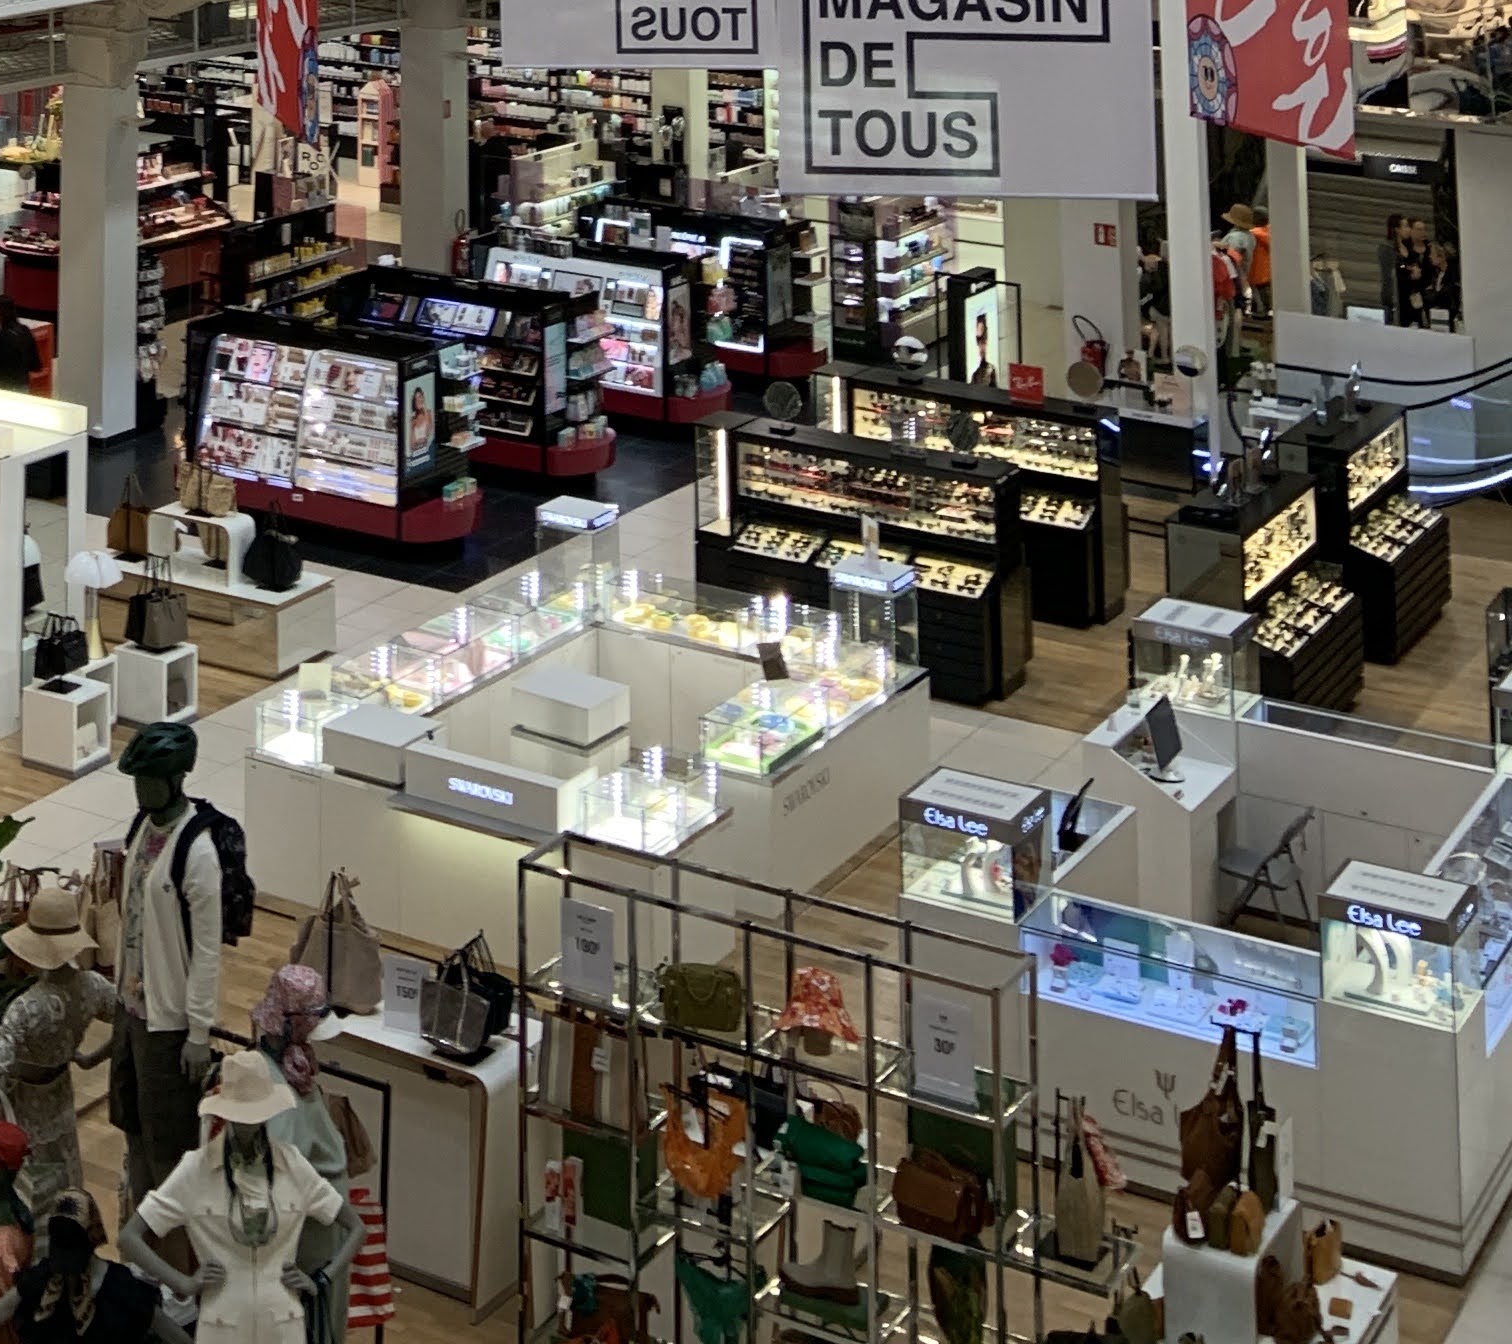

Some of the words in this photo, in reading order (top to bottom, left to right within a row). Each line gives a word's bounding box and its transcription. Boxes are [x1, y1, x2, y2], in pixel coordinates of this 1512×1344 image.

[820, 41, 896, 88] DE
[818, 109, 978, 159] TOUS
[923, 807, 955, 829] Elsa
[957, 815, 988, 837] Lee
[1347, 905, 1383, 928] Elsa
[1386, 914, 1421, 936] Lee
[1112, 1089, 1164, 1125] Elsa
